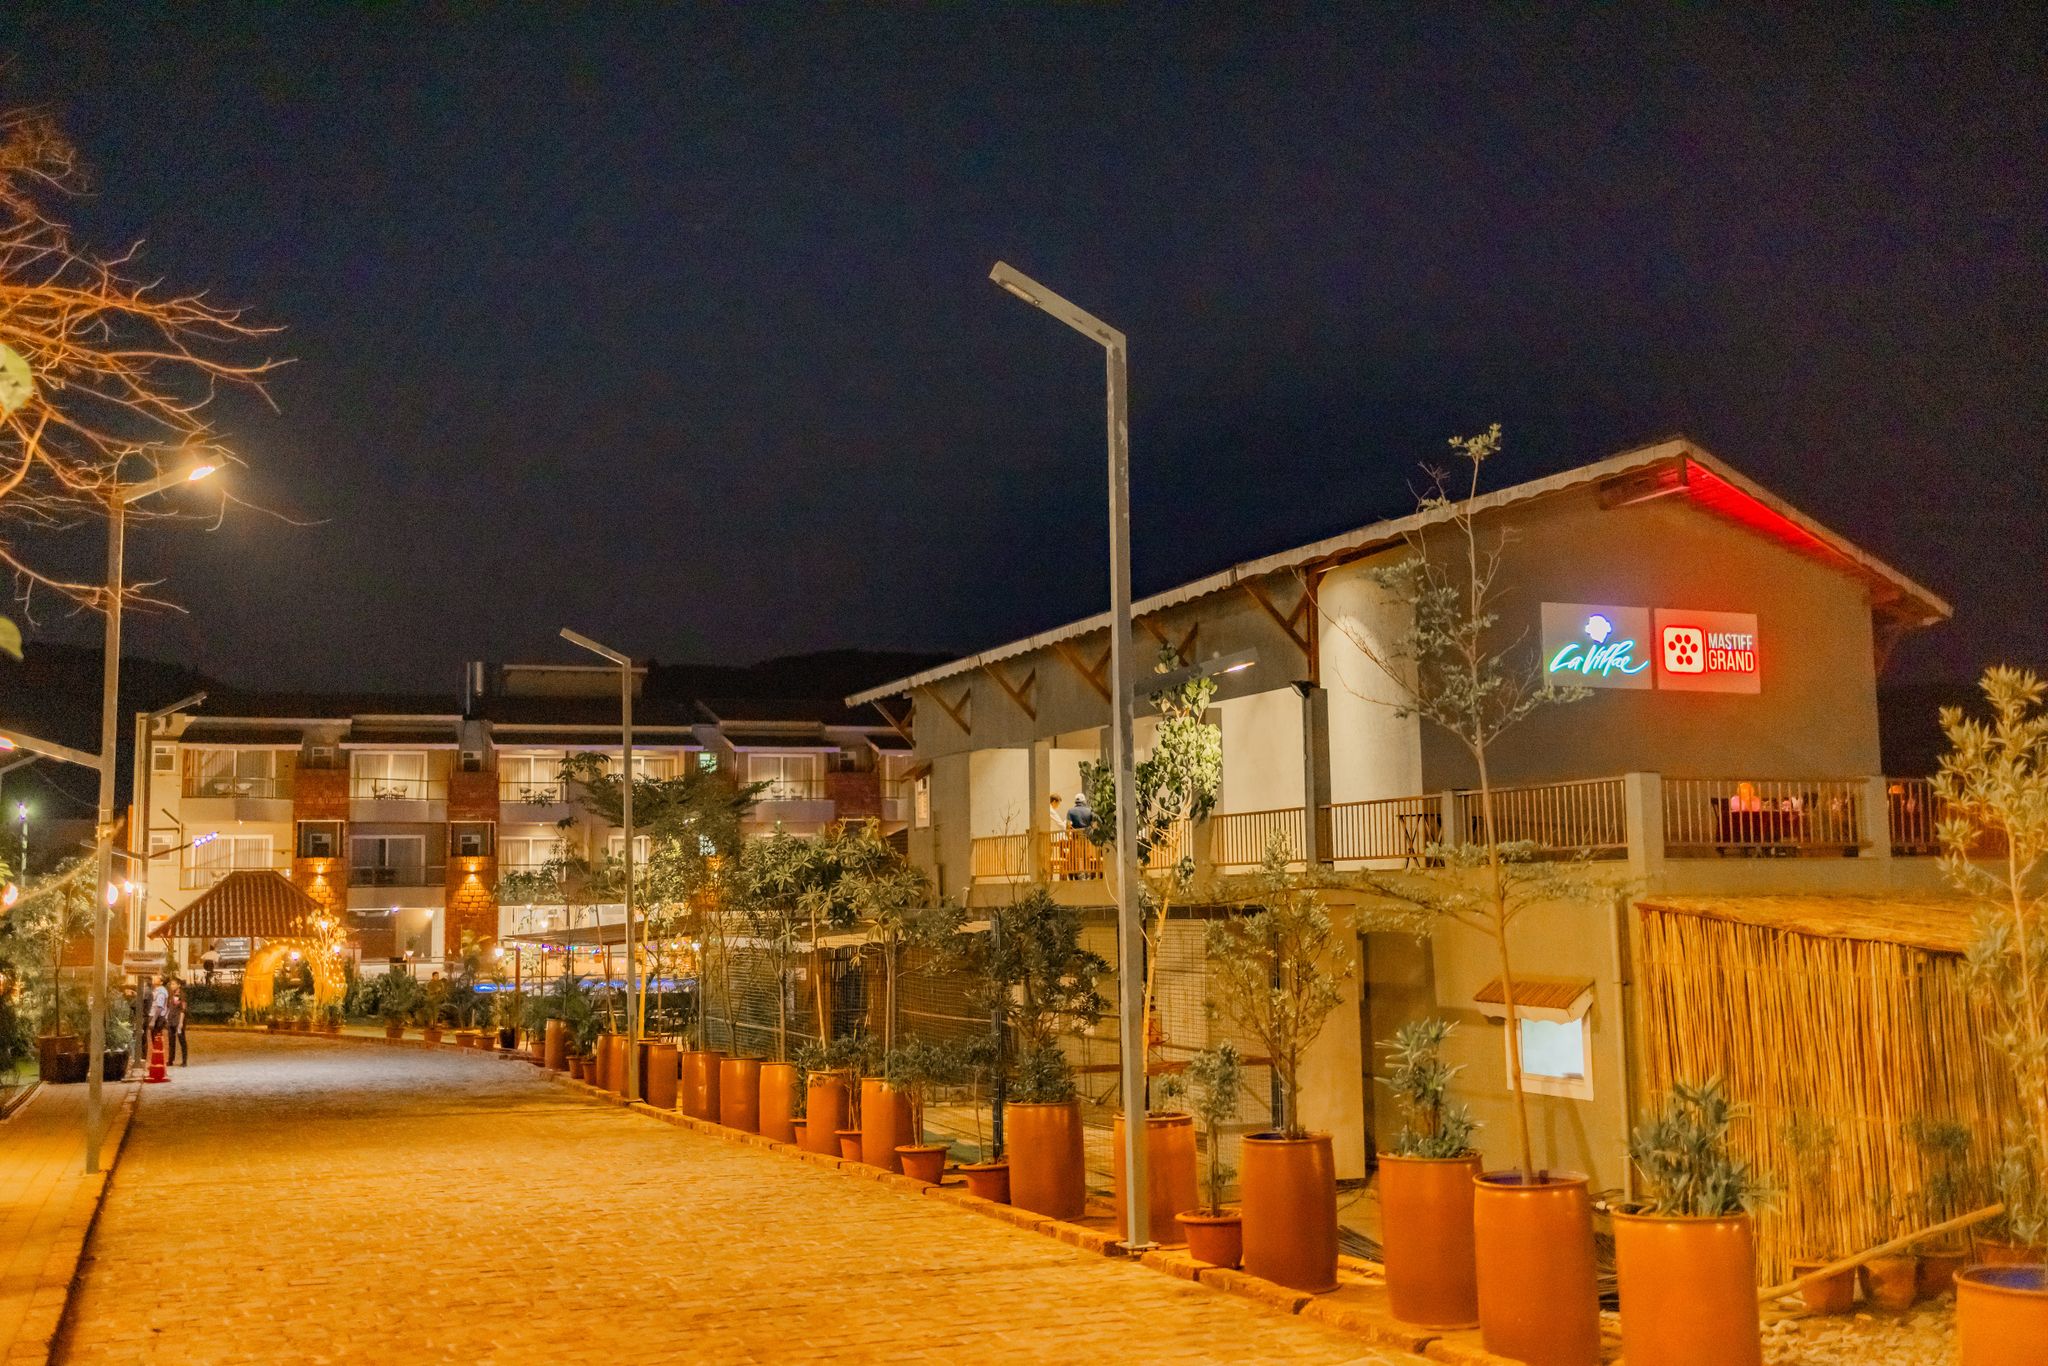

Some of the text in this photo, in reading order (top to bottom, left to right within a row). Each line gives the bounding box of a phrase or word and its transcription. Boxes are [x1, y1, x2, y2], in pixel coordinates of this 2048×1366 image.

[1708, 632, 1753, 650] MASTIFF
[1549, 643, 1584, 673] La
[1708, 649, 1755, 672] GRAND
